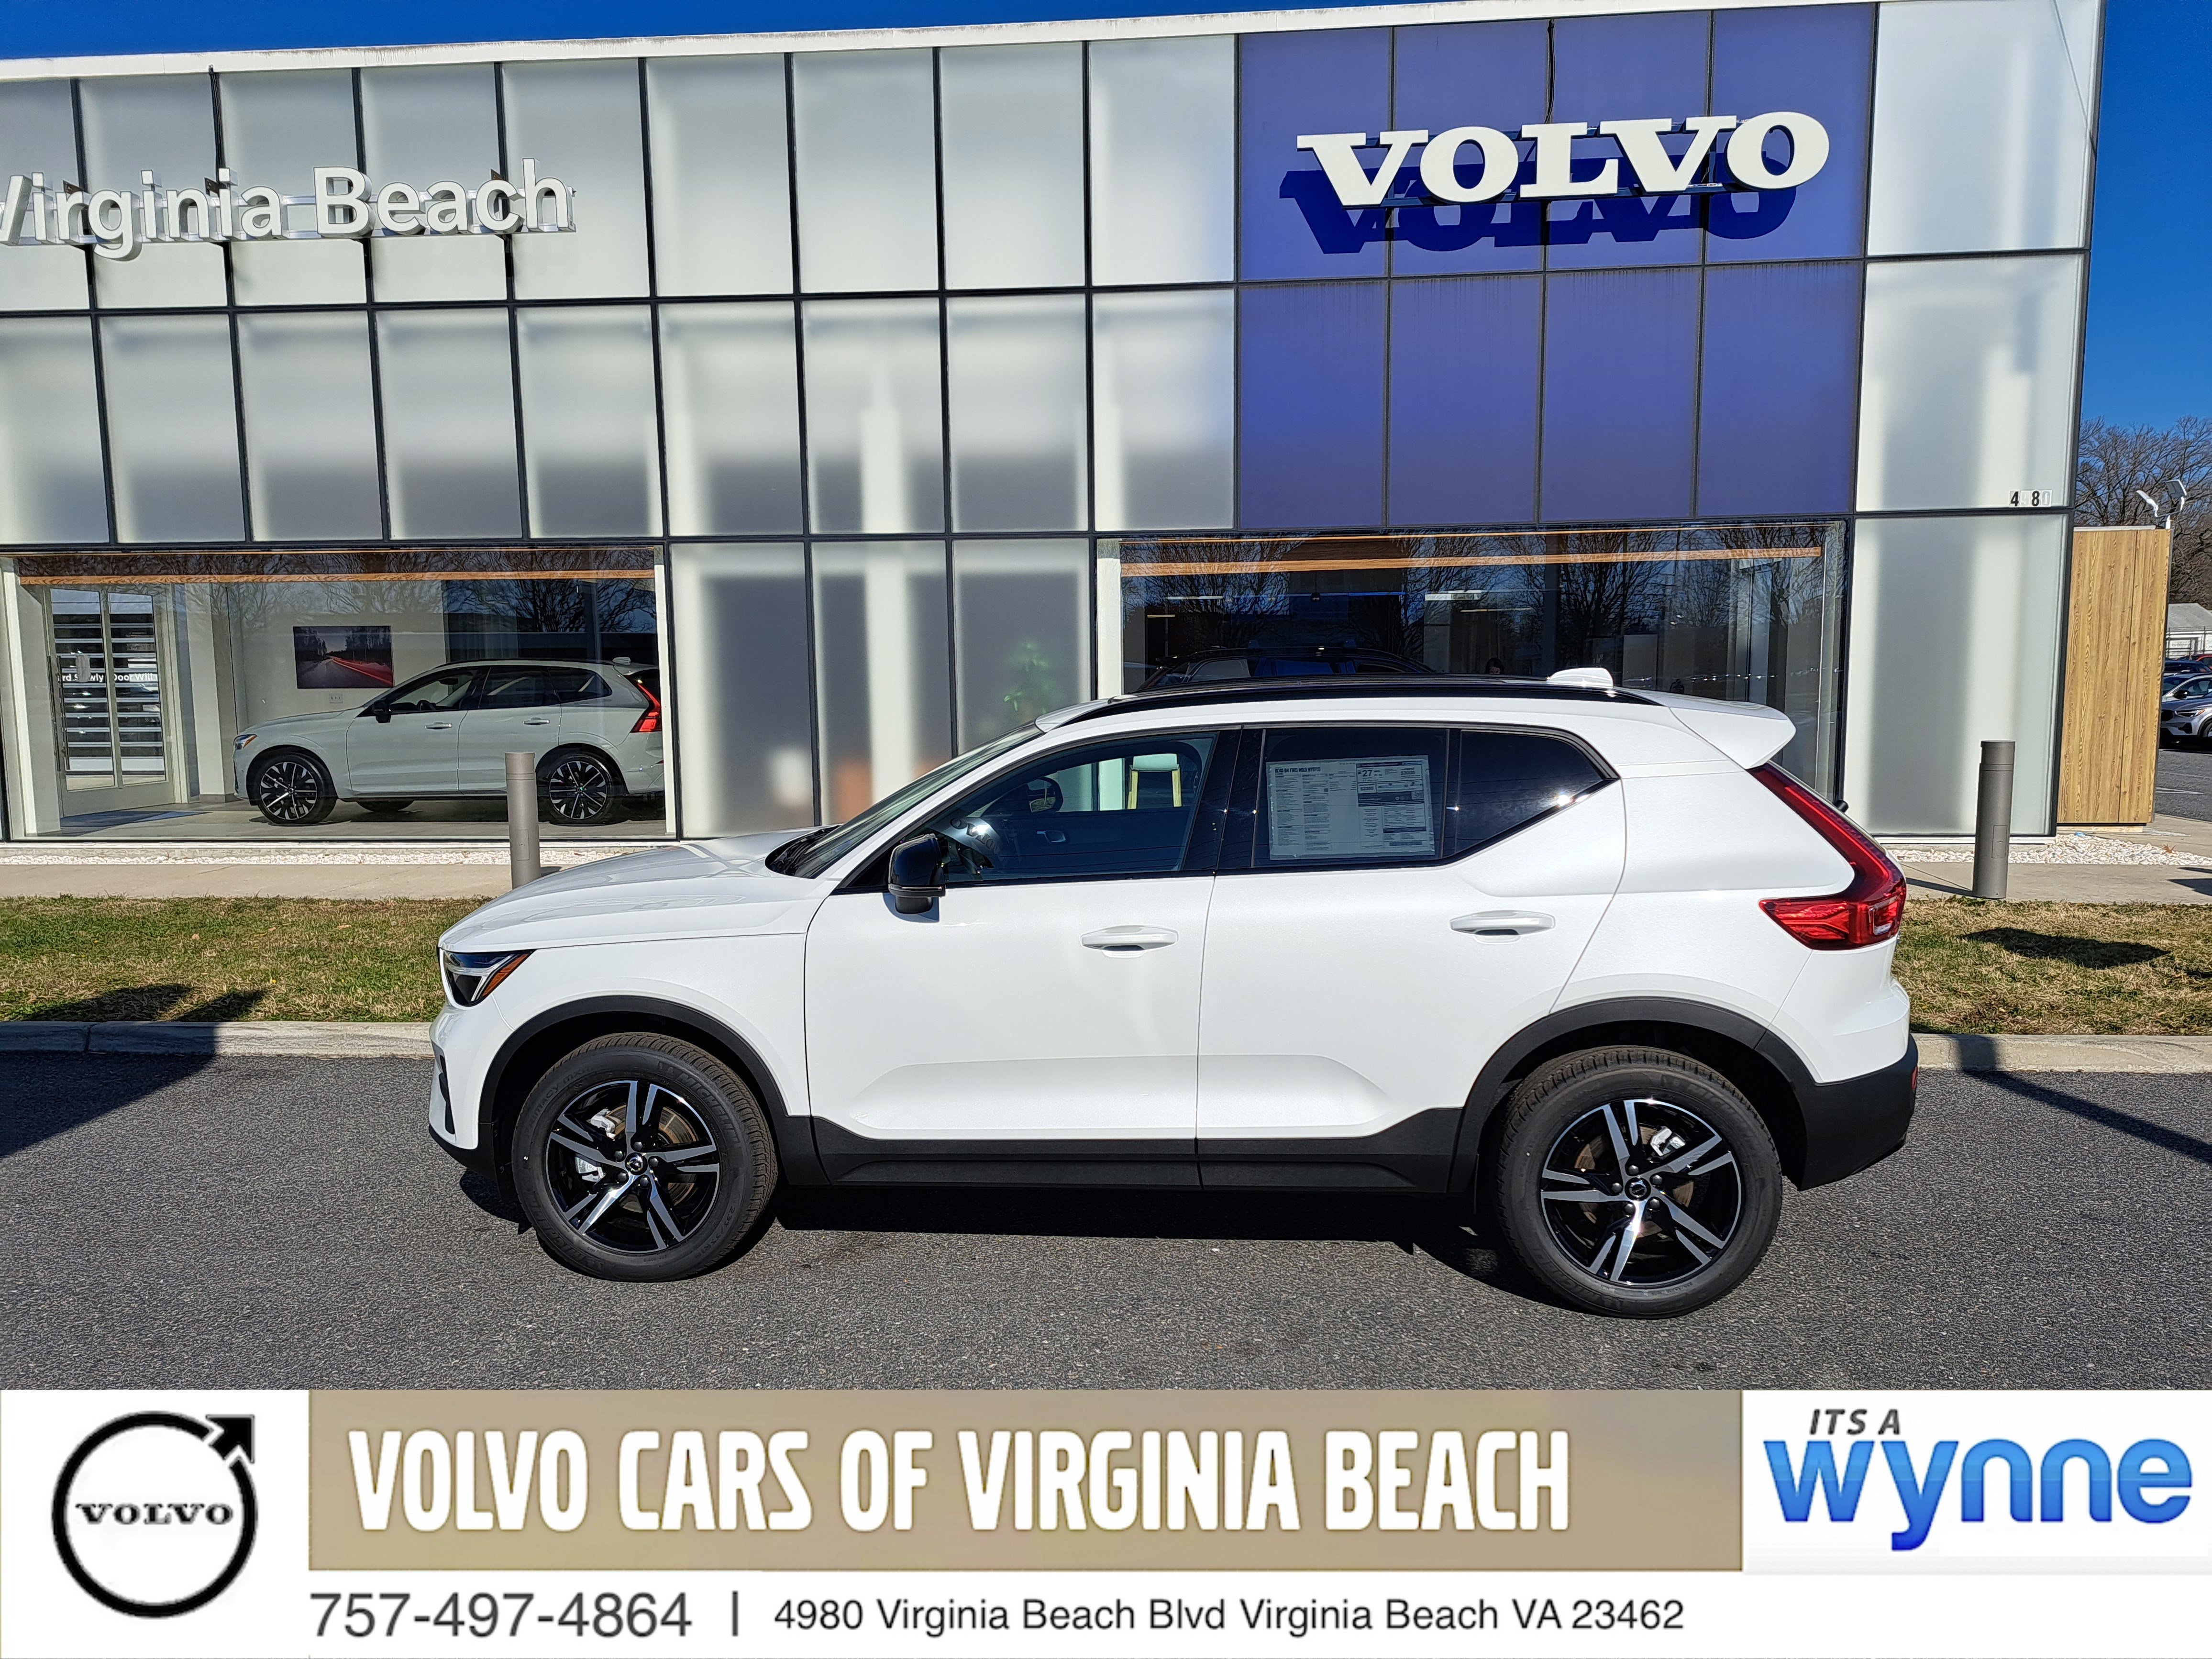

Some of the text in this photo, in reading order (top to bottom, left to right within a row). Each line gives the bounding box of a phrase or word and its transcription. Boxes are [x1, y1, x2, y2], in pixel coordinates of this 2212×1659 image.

[313, 158, 576, 238] Beach
[1296, 111, 1830, 206] VOLVO
[675, 1072, 741, 1143] MICHELIN
